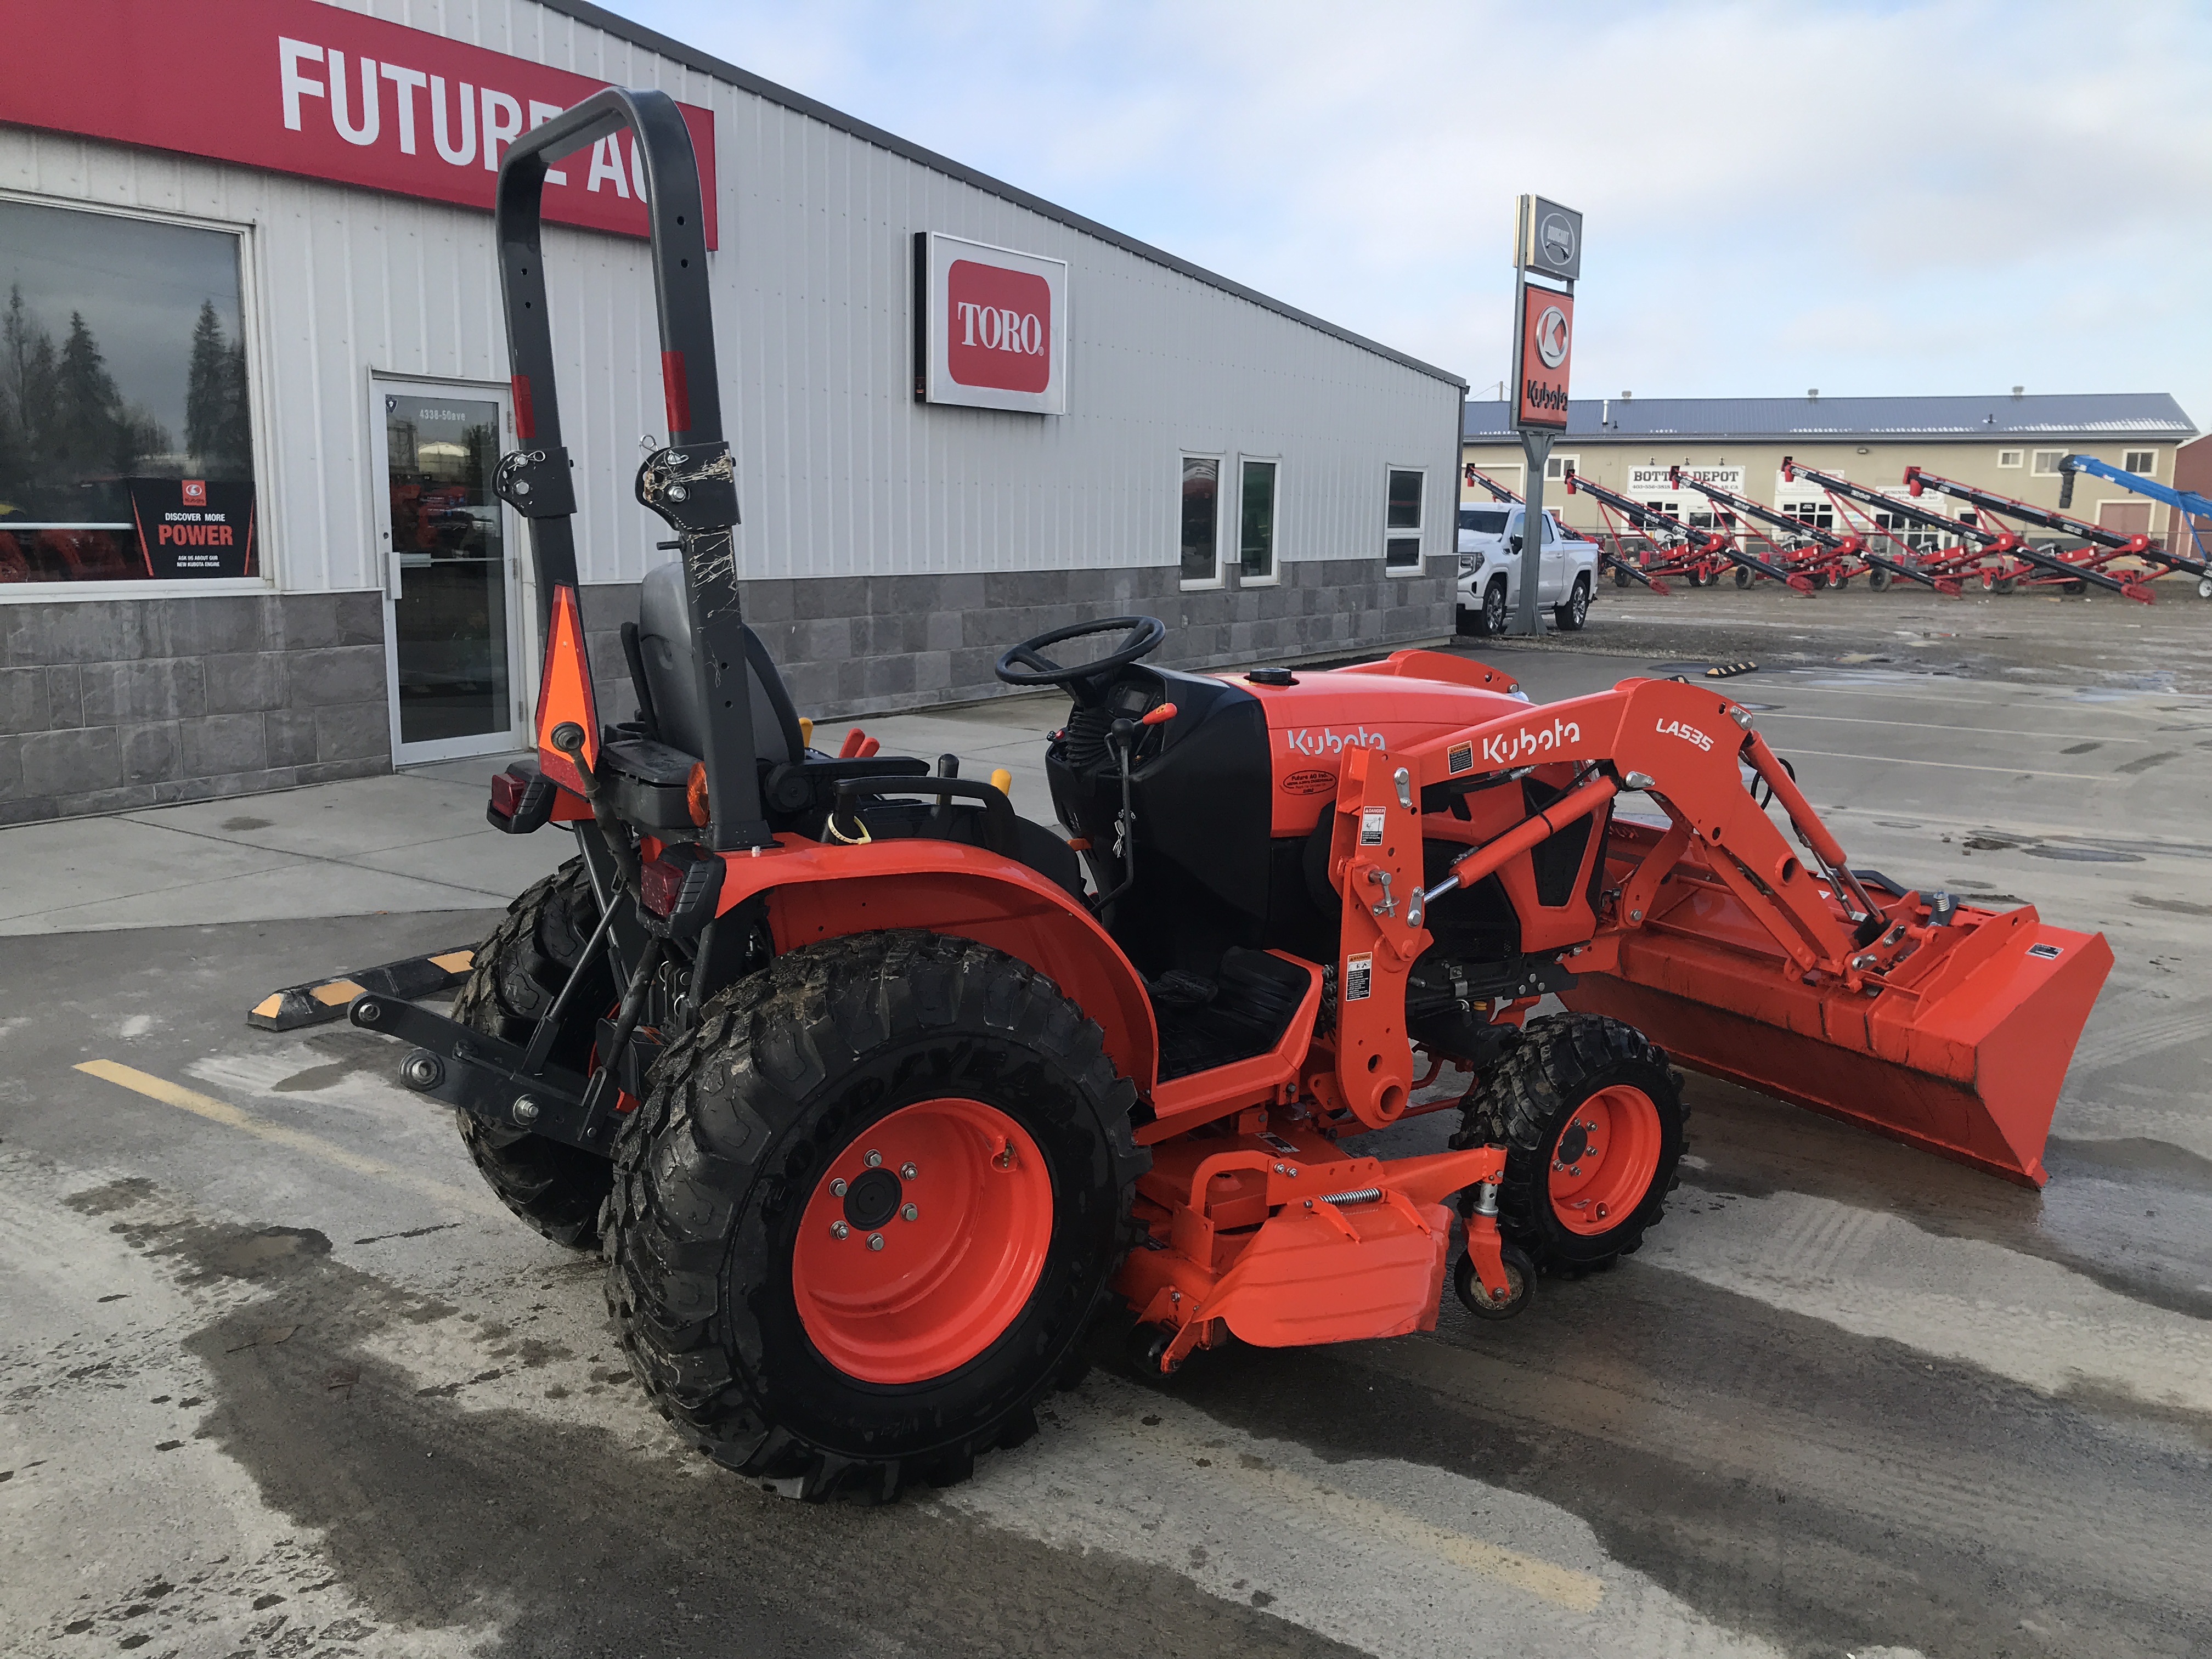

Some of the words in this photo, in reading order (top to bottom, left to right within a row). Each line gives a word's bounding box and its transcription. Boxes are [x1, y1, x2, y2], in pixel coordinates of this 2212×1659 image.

[958, 302, 1042, 356] TORO
[1527, 379, 1568, 411] Kubota
[1693, 471, 1739, 482] DEPOT
[165, 512, 201, 522] DISCOVER
[205, 513, 225, 522] MORE
[158, 524, 234, 546] POWER
[1287, 726, 1386, 756] Kubota
[1483, 718, 1580, 764] Kubota
[1656, 718, 1714, 752] LA535
